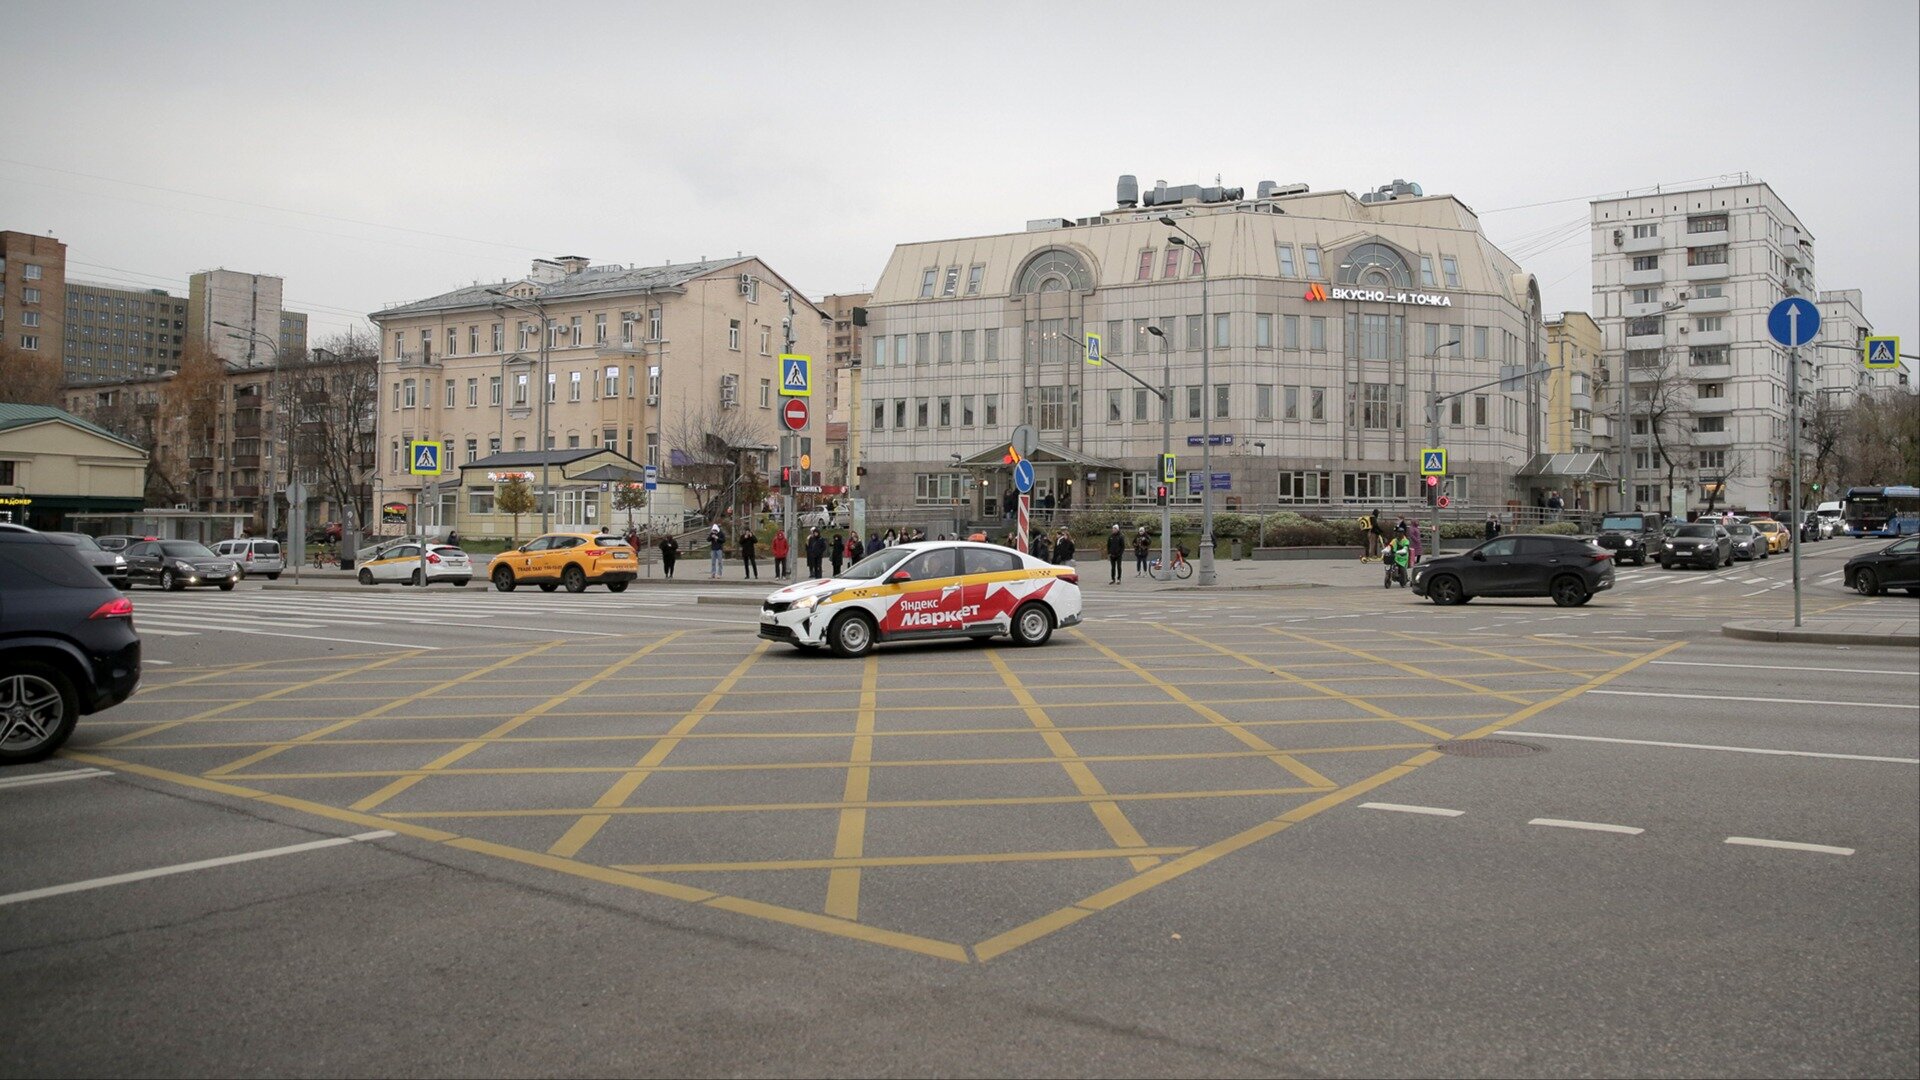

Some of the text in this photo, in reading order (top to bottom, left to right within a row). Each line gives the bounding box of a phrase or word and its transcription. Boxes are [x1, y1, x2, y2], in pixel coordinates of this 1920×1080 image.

[1332, 288, 1384, 302] ВКУСНО
[1397, 293, 1407, 303] И
[1409, 294, 1452, 307] ТОЧКА
[900, 599, 939, 611] Яндекс
[900, 604, 980, 627] Маркет
